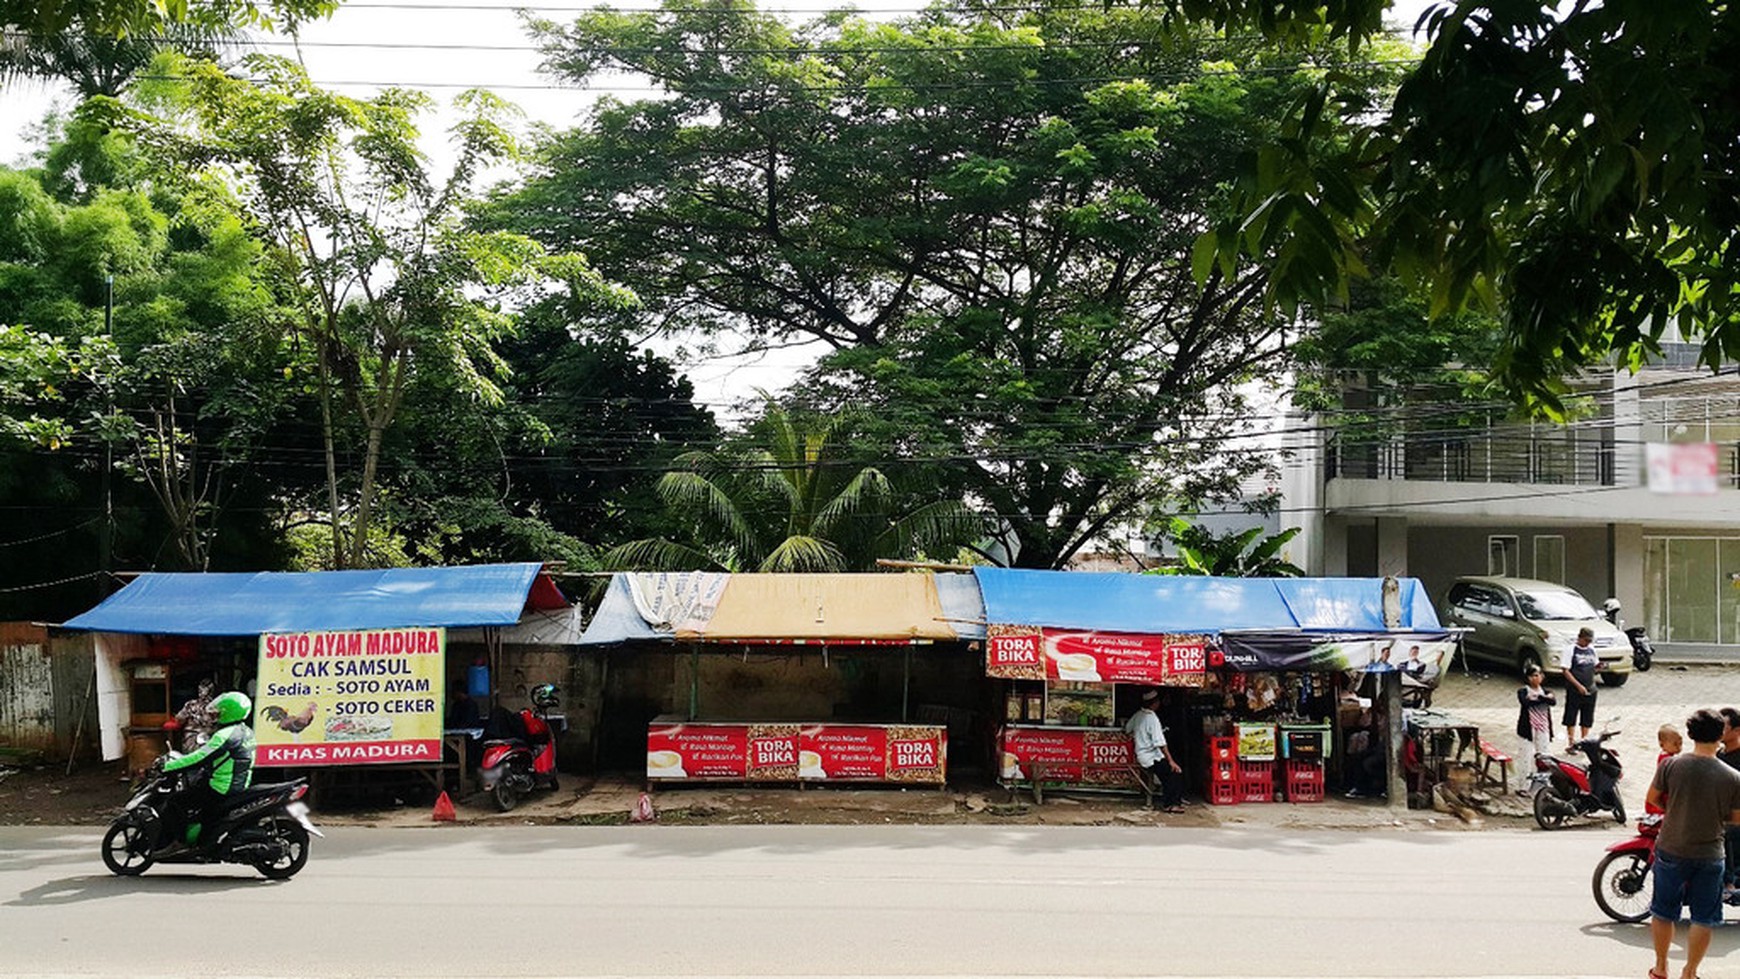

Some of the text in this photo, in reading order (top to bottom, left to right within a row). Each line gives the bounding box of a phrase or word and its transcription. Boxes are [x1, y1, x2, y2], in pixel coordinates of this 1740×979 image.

[266, 630, 439, 658] SOTO AYAM MADURA
[995, 639, 1034, 650] TORA
[998, 650, 1035, 662] BIKA
[292, 658, 412, 678] CAK SAMSUL
[268, 682, 311, 696] Sedia
[336, 681, 380, 694] SOTO
[384, 679, 430, 692] AYAM
[336, 701, 380, 715] SOTO
[384, 699, 435, 713] CEKER
[756, 740, 794, 751] TORA
[895, 742, 933, 754] TORA
[1090, 746, 1128, 756] TORA
[268, 744, 428, 760] KHAS MADURA
[758, 752, 794, 764] BIKA
[898, 754, 933, 766] BIKA
